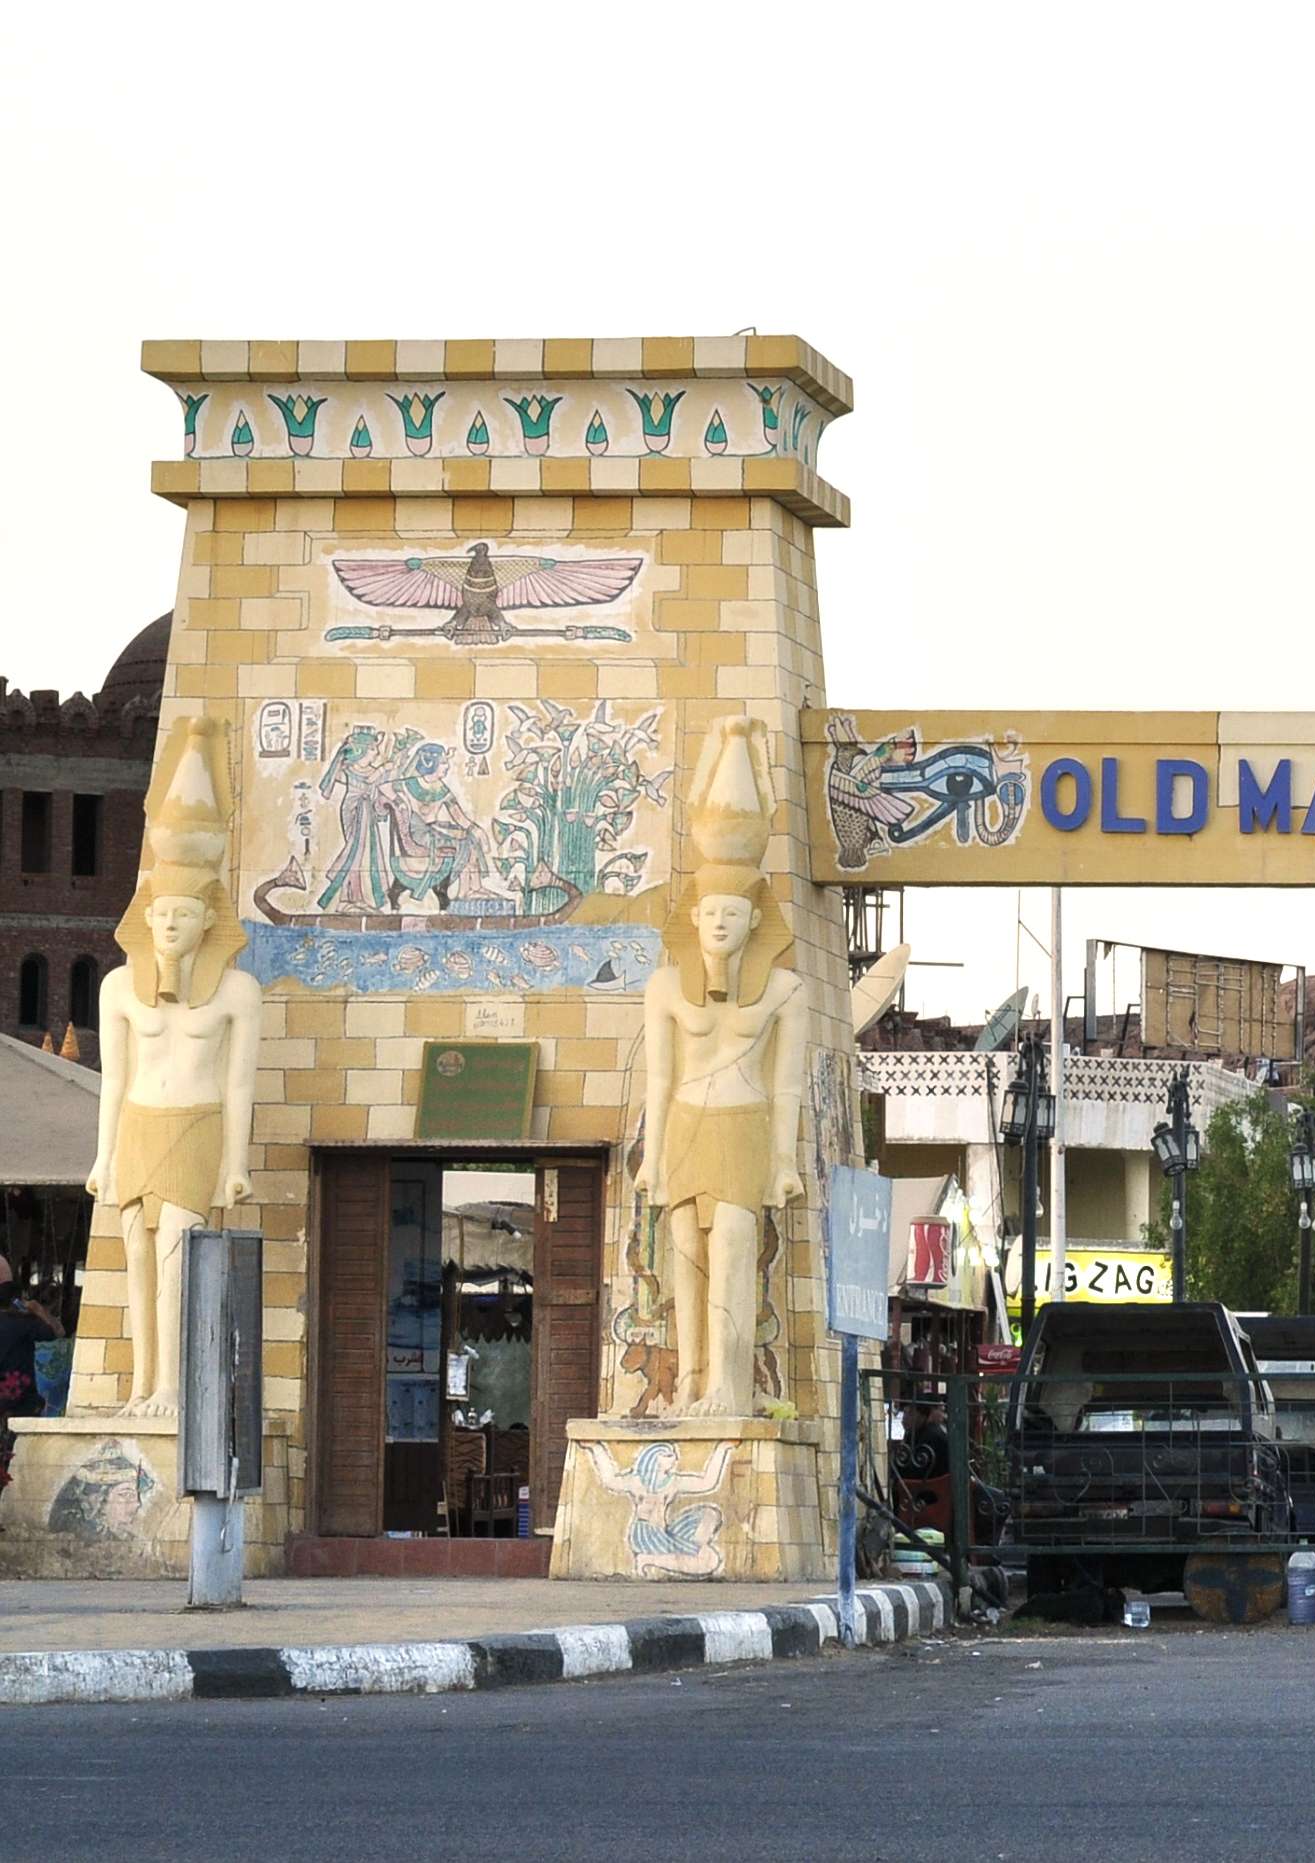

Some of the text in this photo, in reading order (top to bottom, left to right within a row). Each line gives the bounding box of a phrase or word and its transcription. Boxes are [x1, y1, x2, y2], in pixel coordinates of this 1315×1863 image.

[1040, 757, 1208, 836] OLD
[1035, 1262, 1078, 1292] IG
[1088, 1261, 1155, 1294] ZAG
